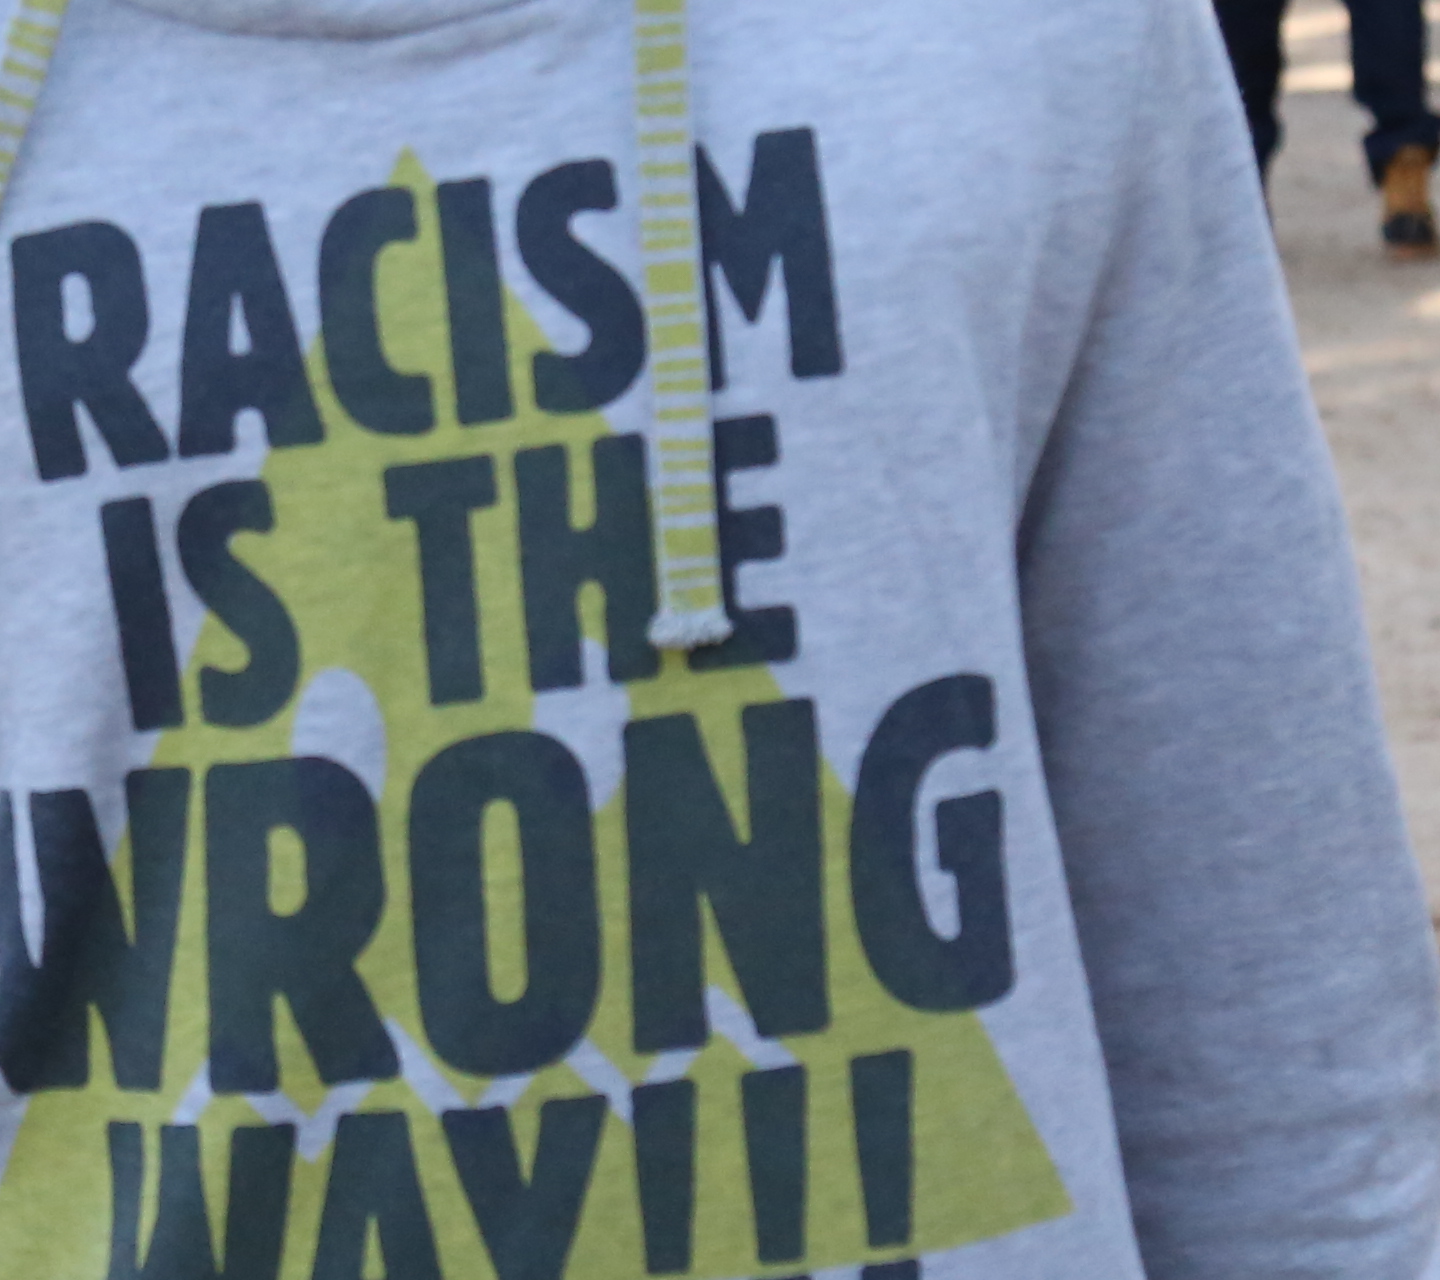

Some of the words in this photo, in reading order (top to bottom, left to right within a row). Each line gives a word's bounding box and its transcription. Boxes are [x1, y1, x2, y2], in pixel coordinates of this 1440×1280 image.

[11, 126, 844, 482] RACISM
[100, 477, 303, 732] IS
[381, 413, 799, 707] THE
